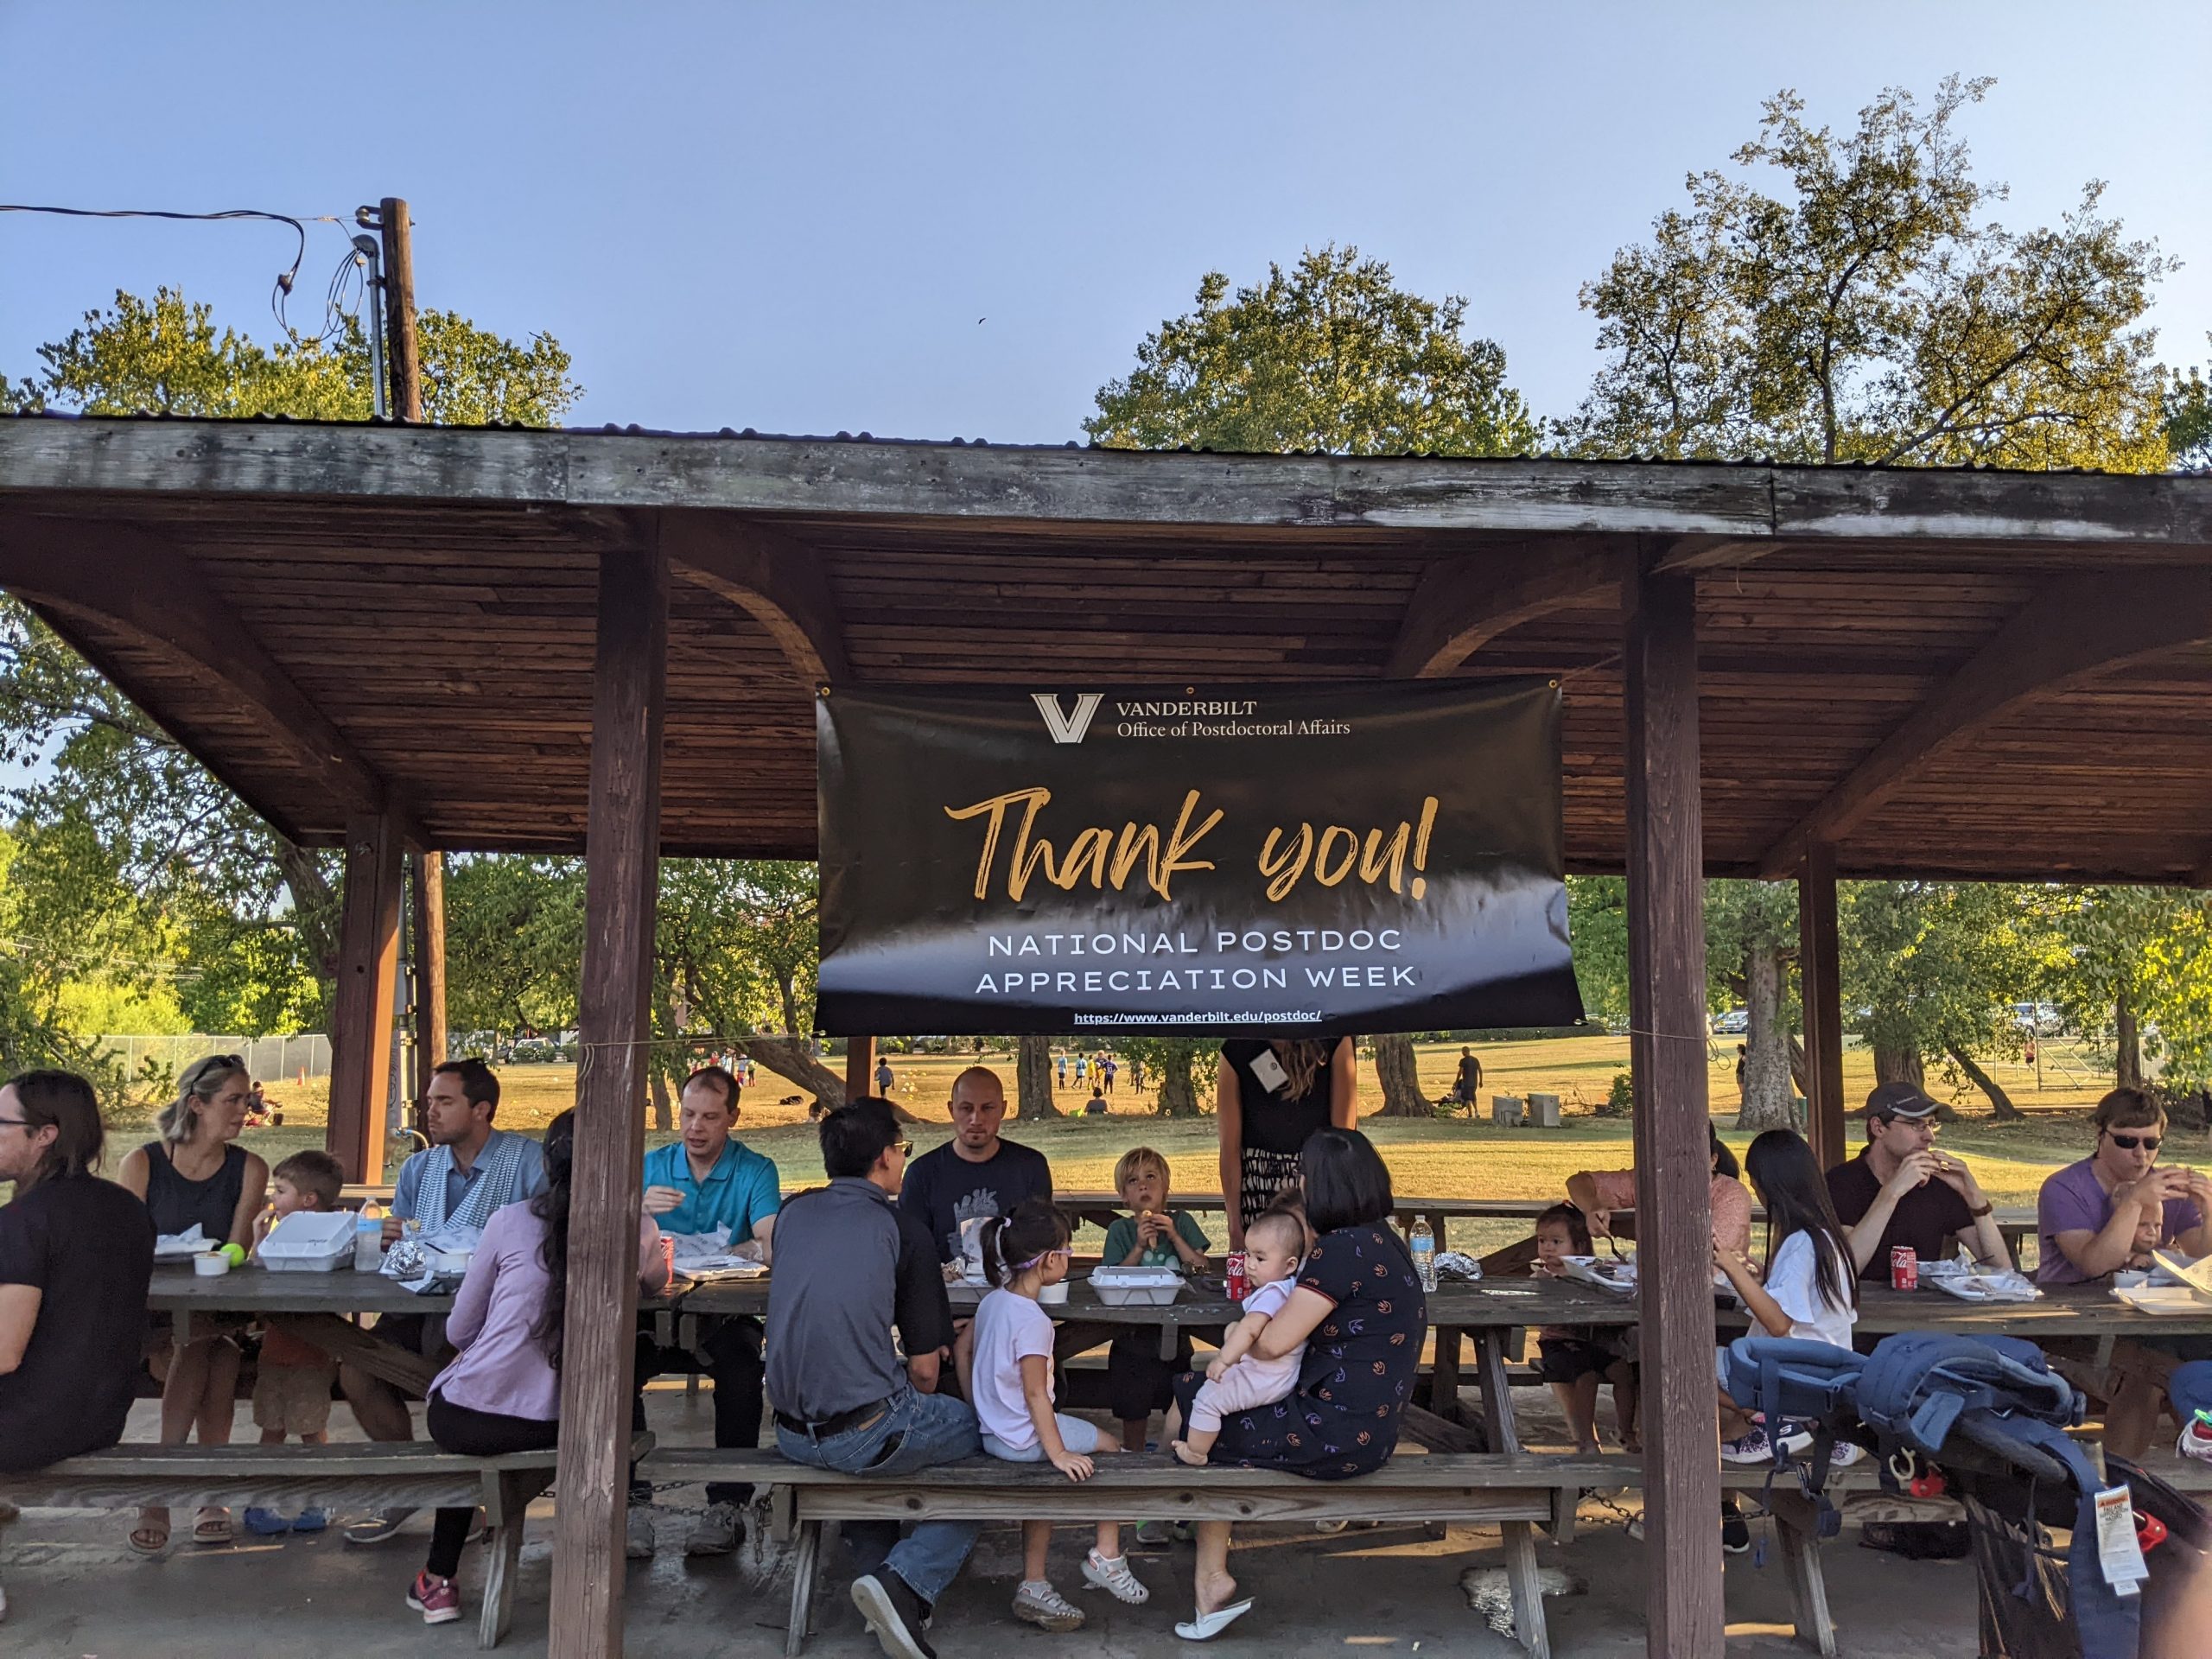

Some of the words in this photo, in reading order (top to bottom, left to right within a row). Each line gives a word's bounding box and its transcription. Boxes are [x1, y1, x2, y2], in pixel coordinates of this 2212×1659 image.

[1030, 693, 1105, 744] V
[1116, 701, 1257, 717] VANDERBILT
[1116, 721, 1166, 738] Office
[1171, 721, 1189, 737] of
[1192, 720, 1293, 737] Postdoctoral
[1297, 719, 1351, 735] Affairs
[944, 786, 1224, 902] Thank
[1258, 796, 1440, 902] you!
[988, 932, 1198, 957] NATIONAL
[1217, 929, 1402, 953] POSTDOC
[975, 968, 1287, 995] APPRECIATION
[1305, 965, 1416, 988] WEEK
[1074, 1009, 1322, 1026] https://www.vanderbilt.edu/postdoc/
